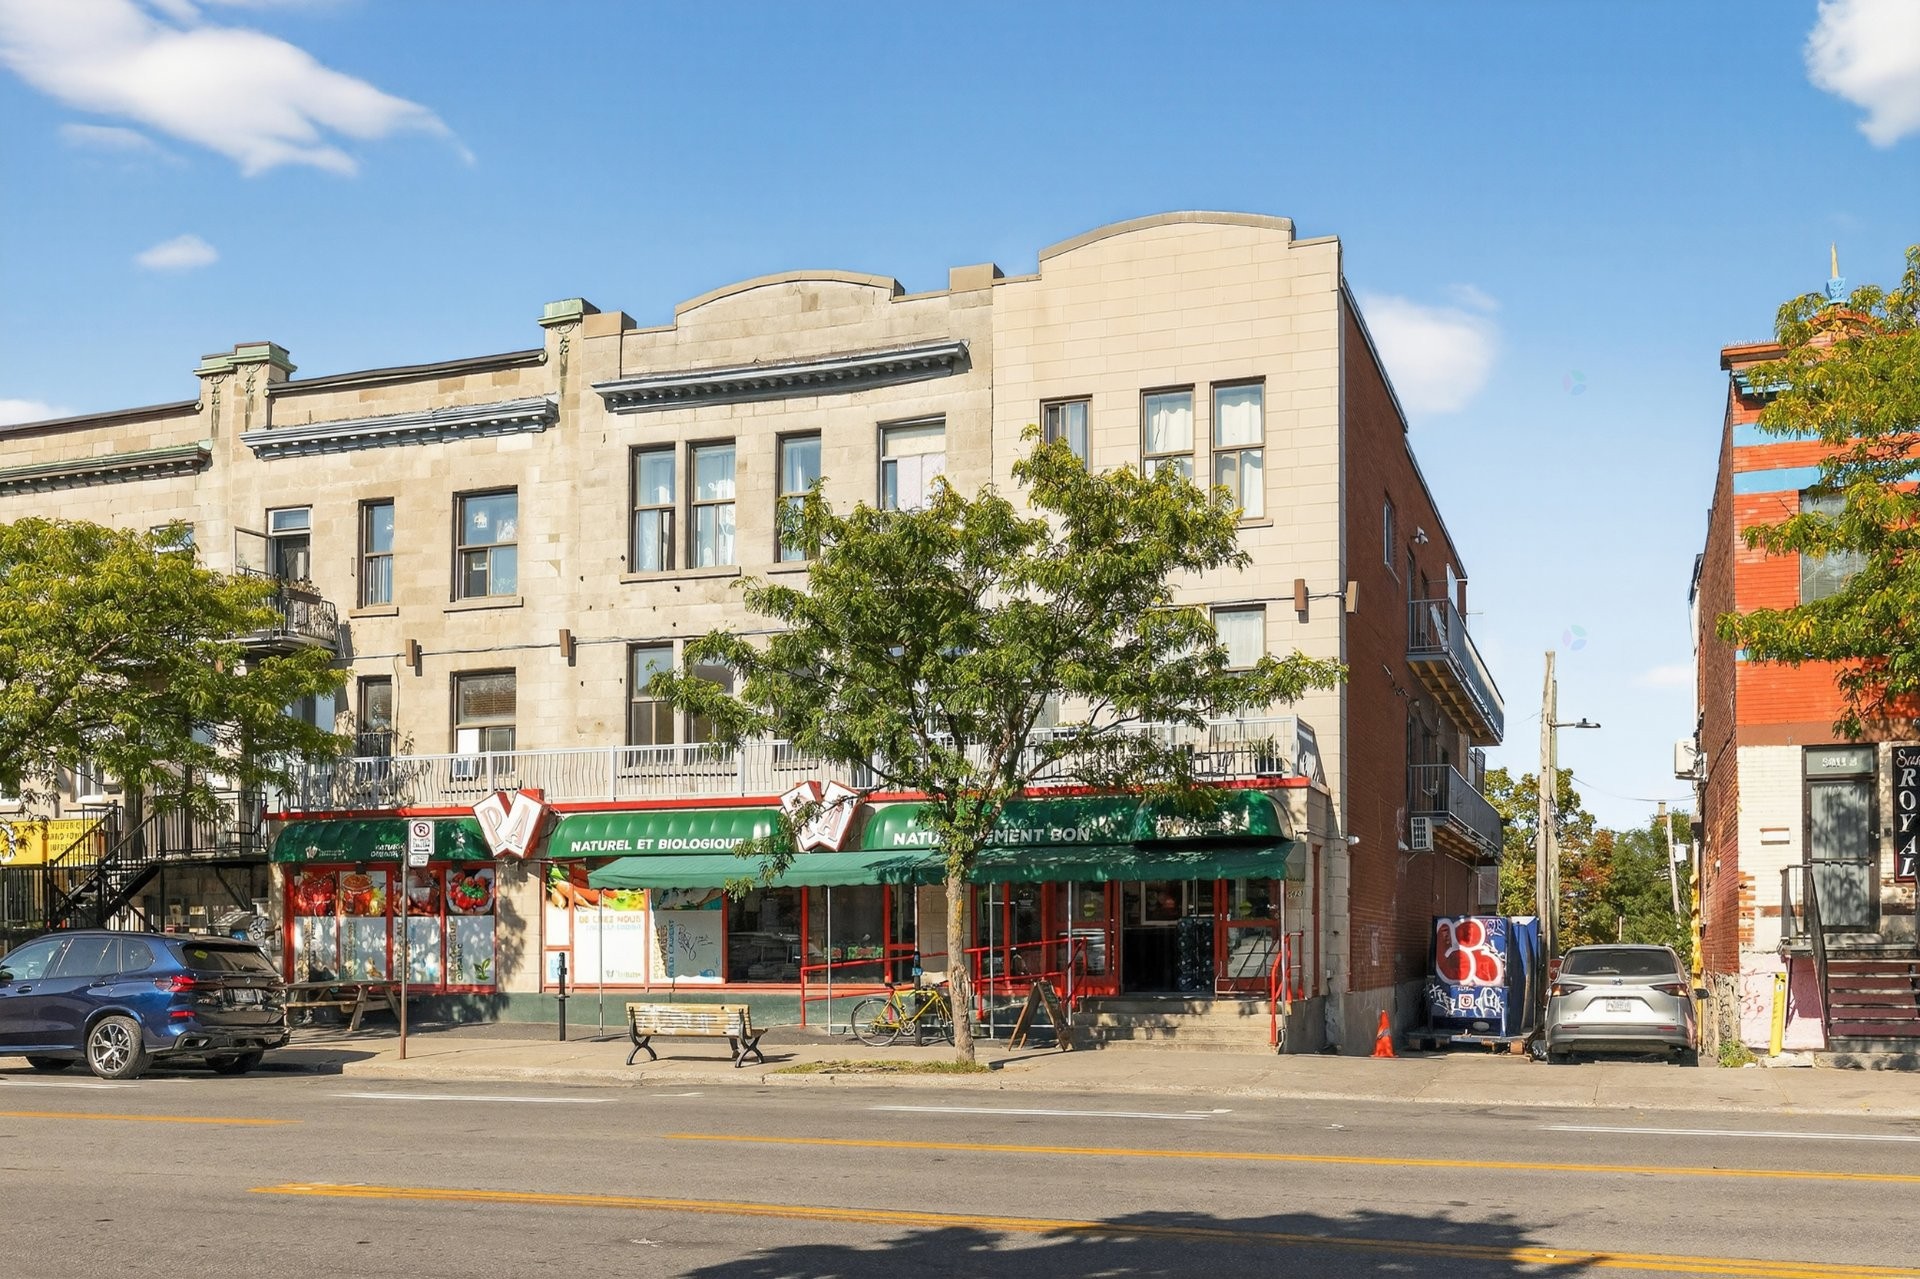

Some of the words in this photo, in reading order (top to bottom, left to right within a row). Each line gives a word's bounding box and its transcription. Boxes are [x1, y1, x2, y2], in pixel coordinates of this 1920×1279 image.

[480, 802, 532, 851] PA
[1050, 827, 1091, 842] BON
[1898, 768, 1917, 877] ROYAL
[571, 840, 632, 852] NATUREL
[637, 839, 654, 849] ET
